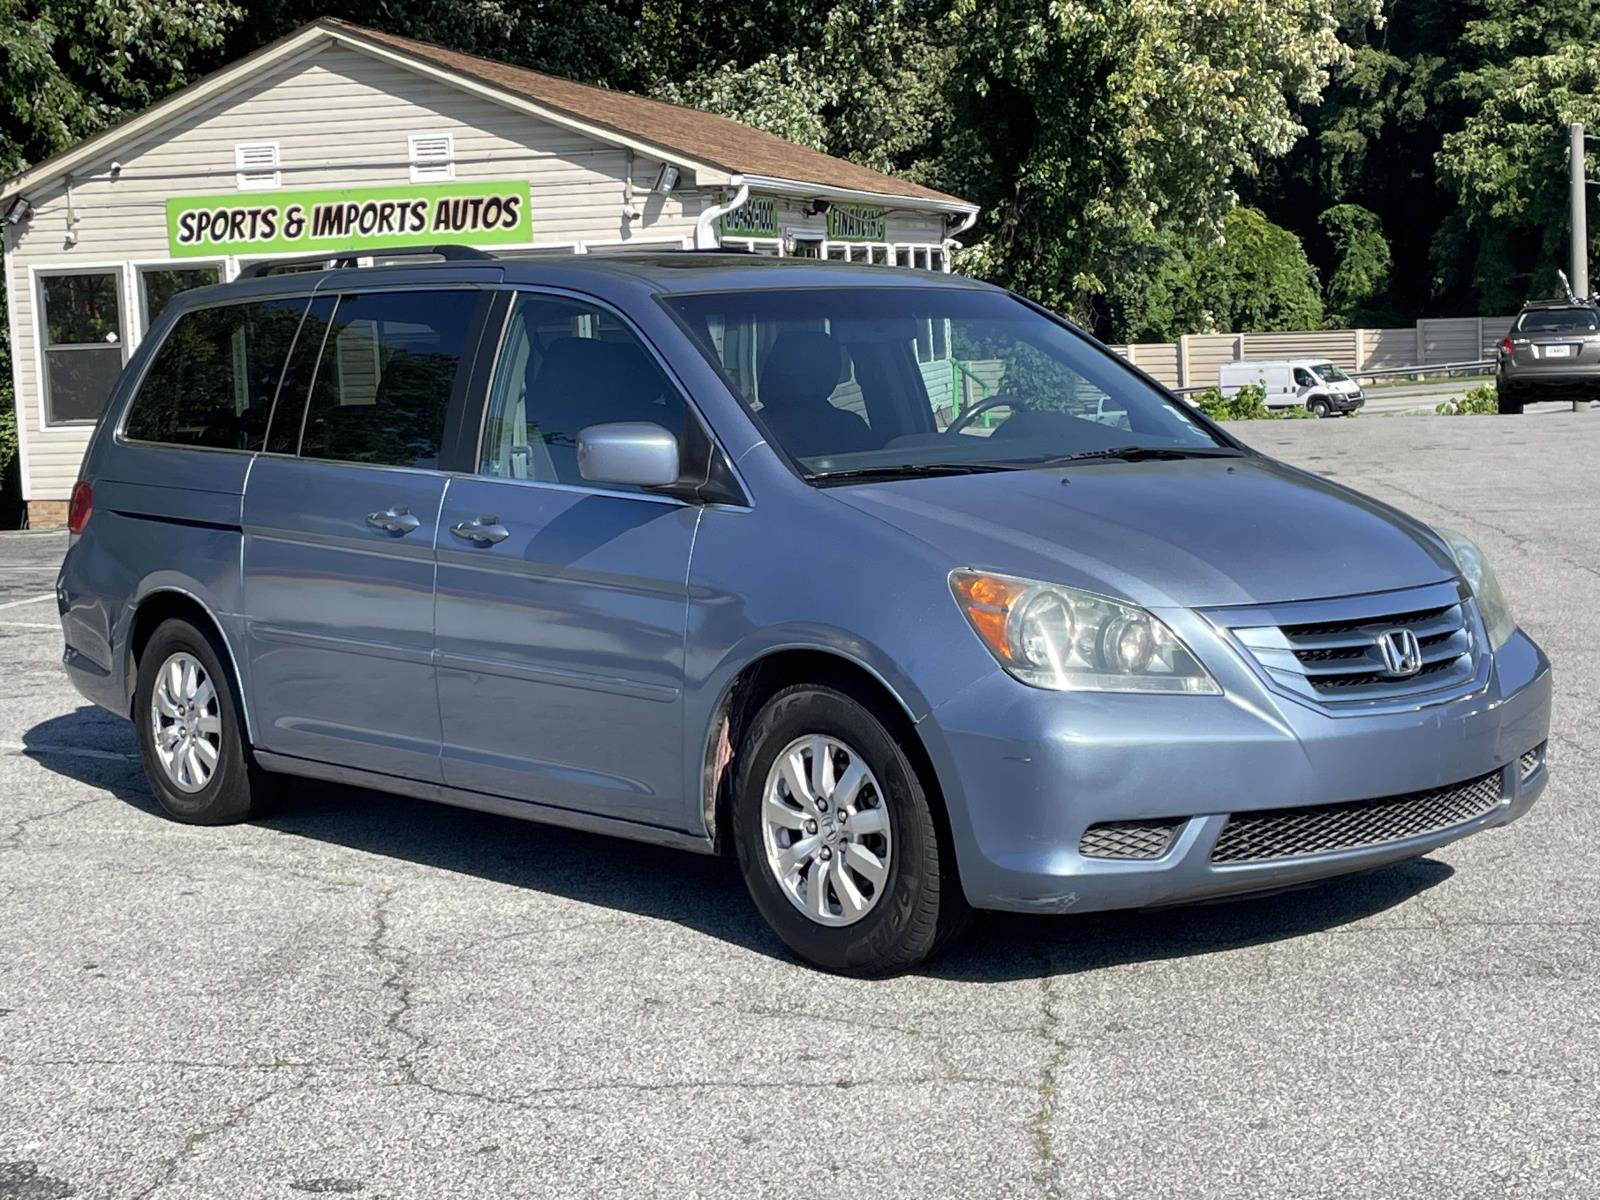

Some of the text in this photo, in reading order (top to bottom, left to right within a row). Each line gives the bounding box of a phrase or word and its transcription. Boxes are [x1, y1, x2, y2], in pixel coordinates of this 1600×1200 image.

[178, 196, 520, 243] SPORTS & IMPORTS AUTOS
[832, 206, 883, 238] FINANCING
